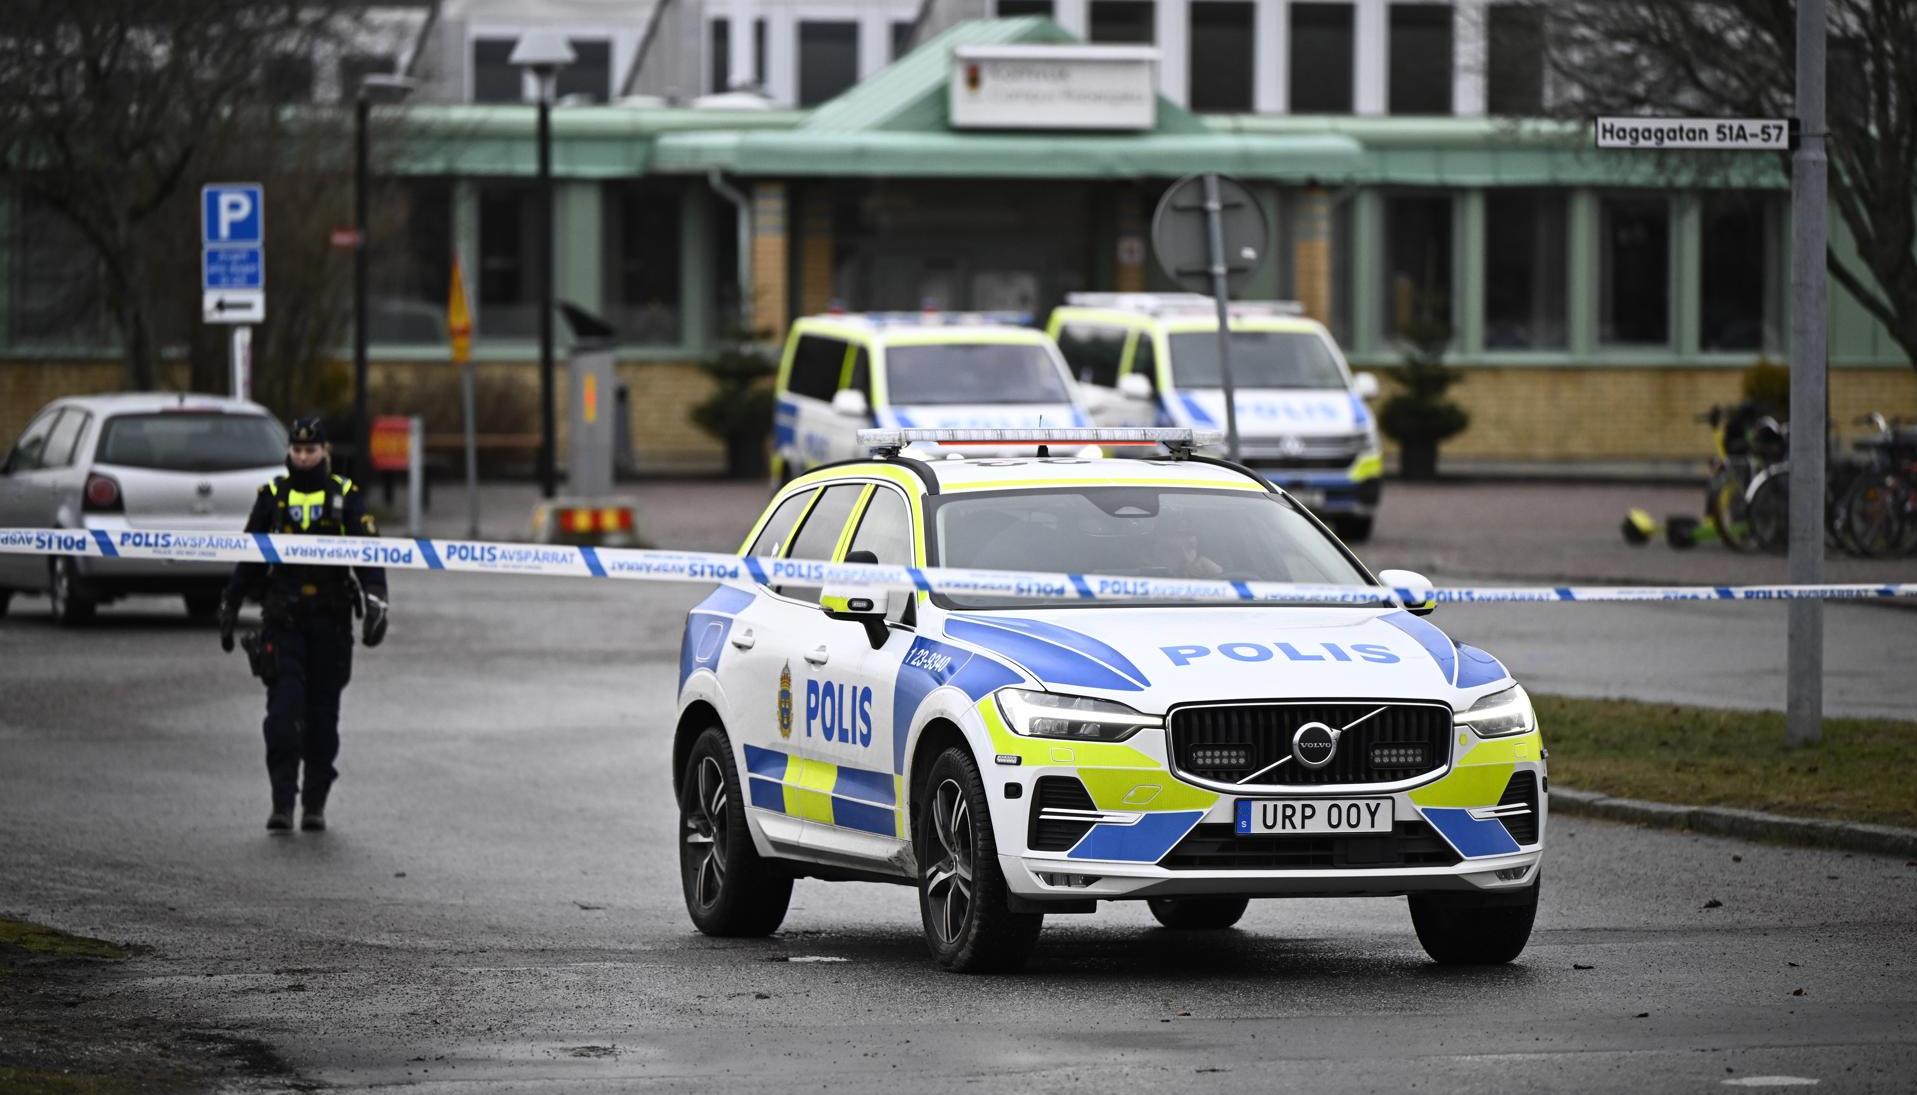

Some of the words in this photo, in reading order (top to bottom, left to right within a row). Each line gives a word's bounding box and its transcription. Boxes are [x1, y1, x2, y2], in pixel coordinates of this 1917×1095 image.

[1602, 122, 1709, 145] Hagagatan
[219, 193, 252, 239] P
[35, 533, 87, 551] POLIS
[119, 531, 172, 548] POLIS
[361, 546, 412, 564] POLIS
[446, 544, 497, 562] POLIS
[688, 562, 739, 579] POLIS
[773, 561, 823, 579] POLIS
[1099, 579, 1149, 596] POLIS
[1424, 590, 1475, 602] POLIS
[911, 649, 951, 672] 23-9340
[1159, 642, 1401, 667] POLIS
[806, 679, 872, 748] POLIS
[1262, 803, 1316, 830] URP
